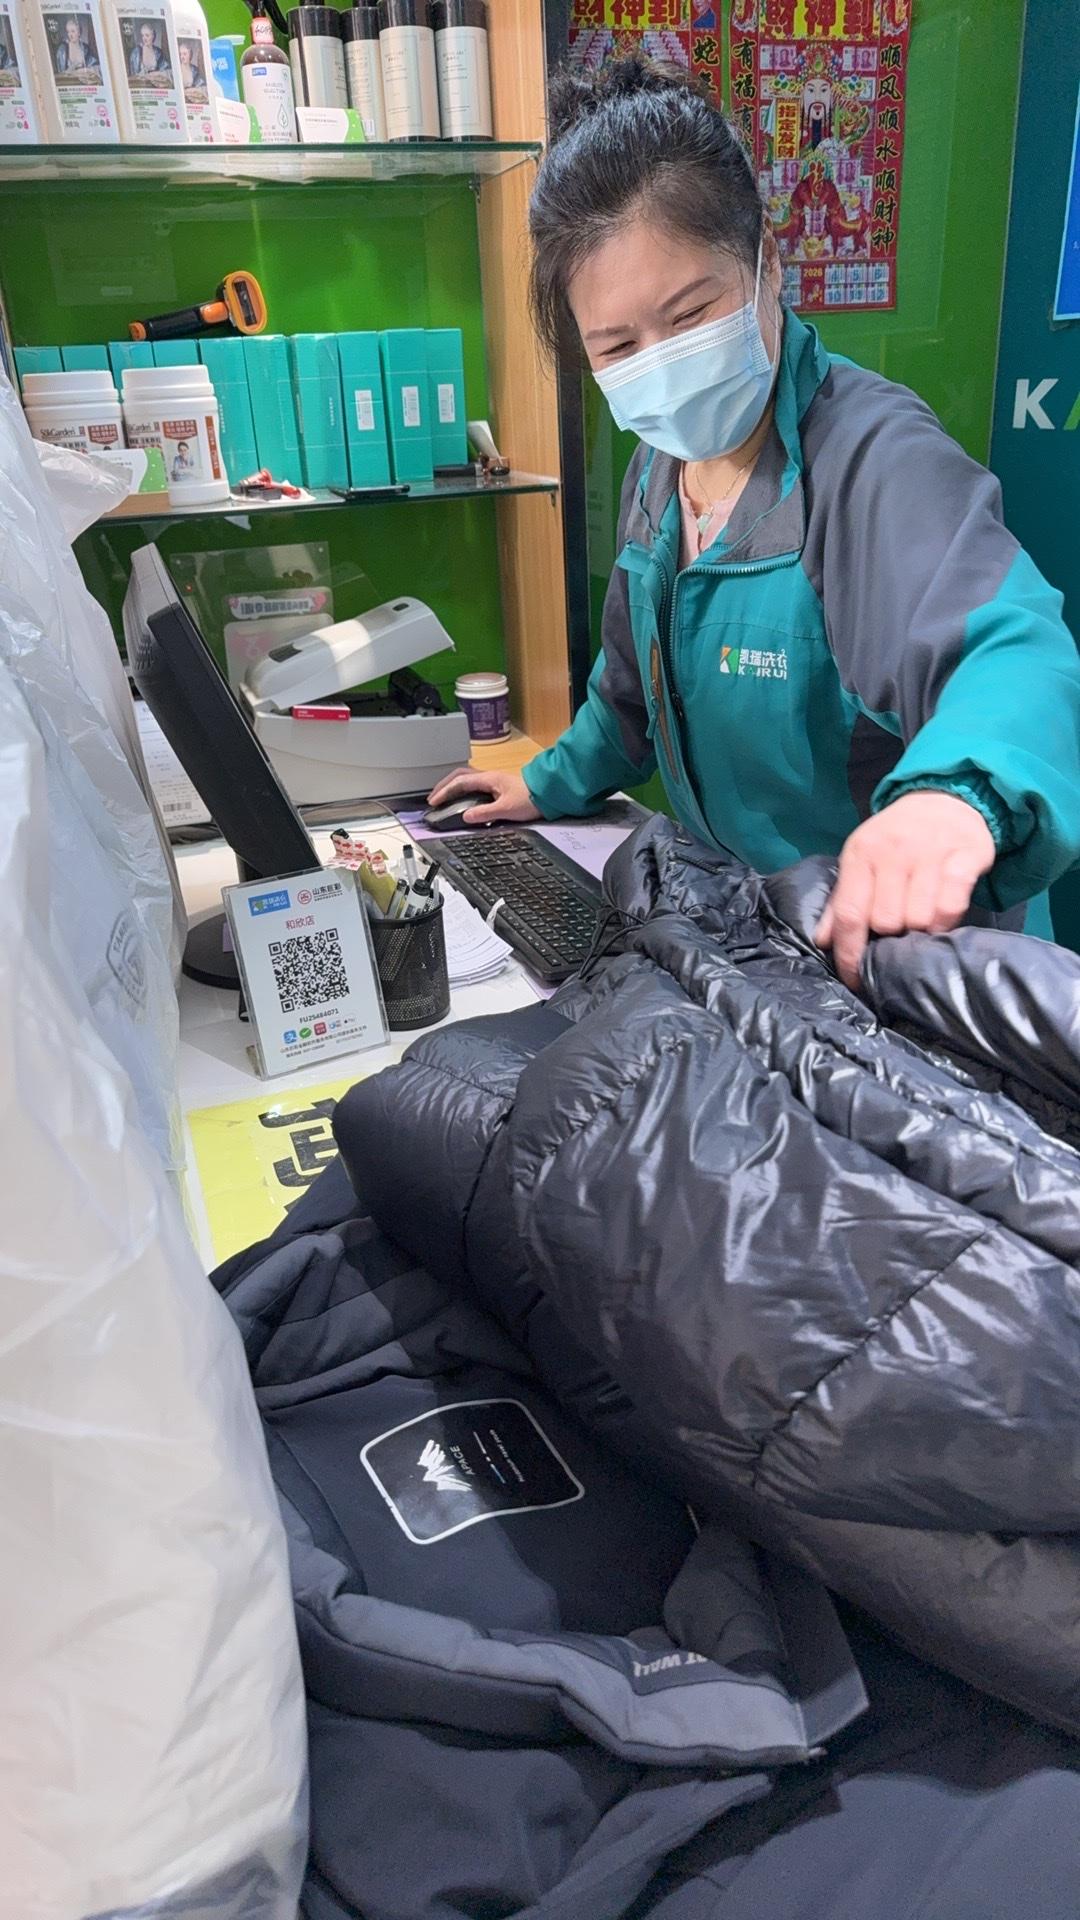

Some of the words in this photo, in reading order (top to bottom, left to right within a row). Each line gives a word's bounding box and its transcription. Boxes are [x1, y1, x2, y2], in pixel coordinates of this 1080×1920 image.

[777, 104, 797, 159] 指定发财
[872, 44, 903, 255] 顺风顺水顺财神
[739, 648, 788, 670] 凯瑞洗衣
[450, 1445, 476, 1475] APACE
